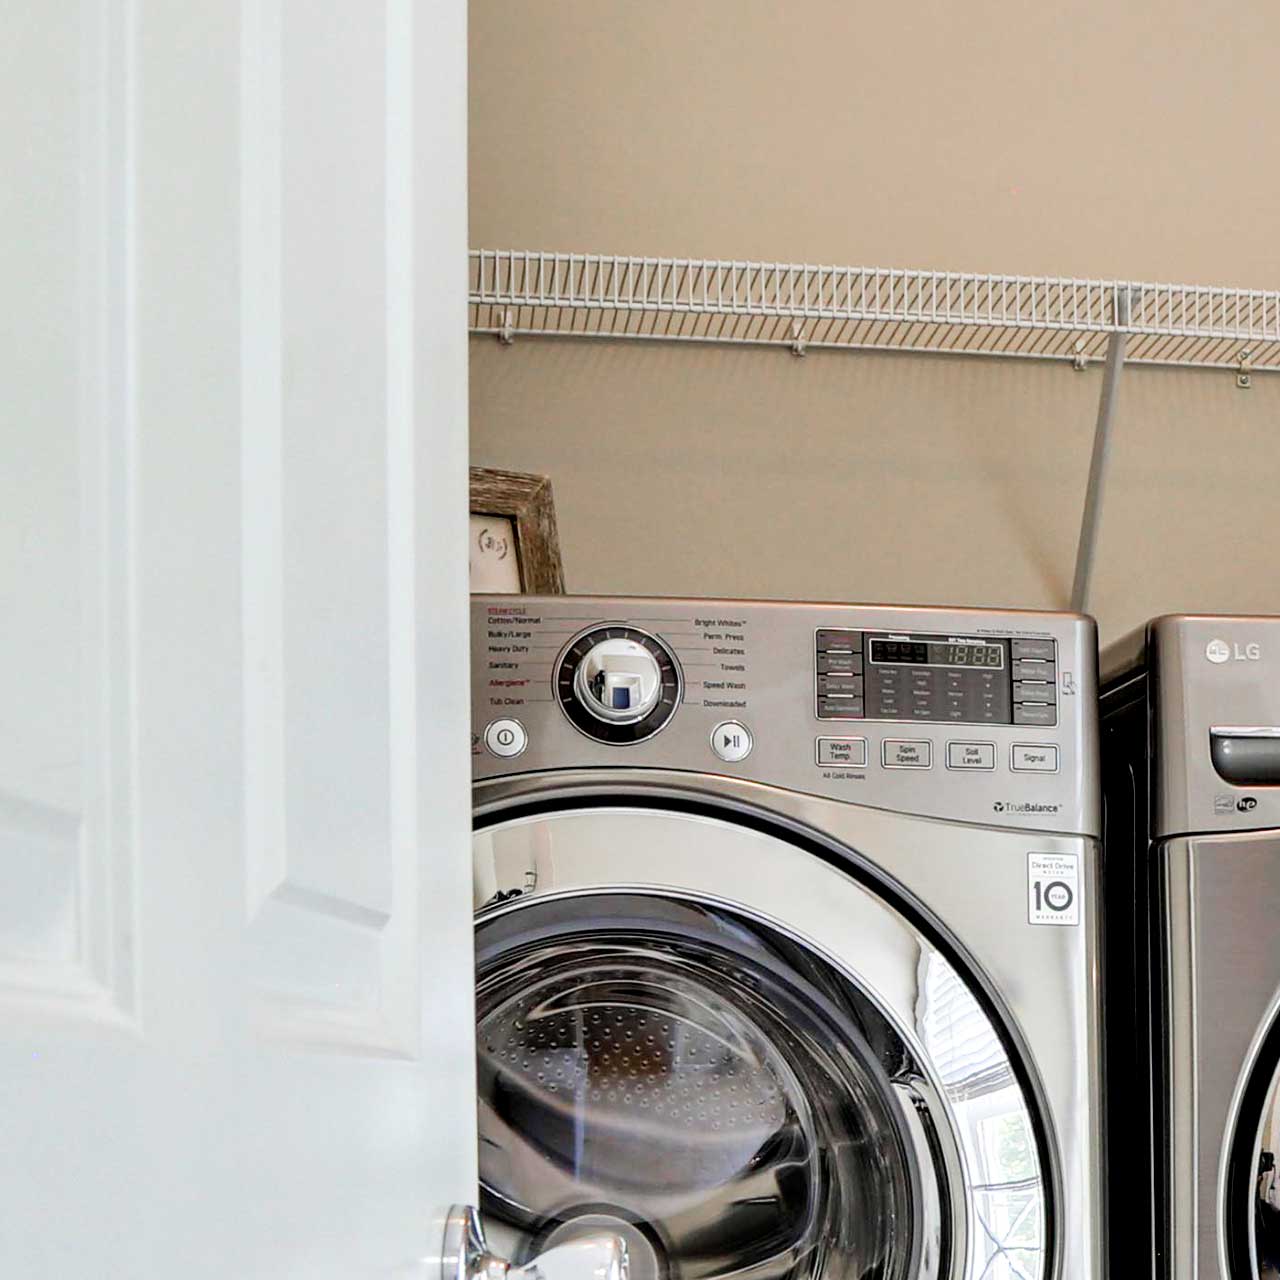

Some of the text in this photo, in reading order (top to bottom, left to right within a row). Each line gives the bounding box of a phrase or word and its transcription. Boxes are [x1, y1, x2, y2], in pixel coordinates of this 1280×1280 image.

[487, 616, 541, 624] Cotton/Normal
[694, 618, 716, 627] Bright
[488, 630, 531, 639] Bulky/Large
[725, 633, 744, 641] Press
[488, 645, 529, 653] Heavy Duty
[713, 647, 745, 655] Delicates
[1233, 642, 1261, 660] LG
[488, 661, 518, 669] Sanitary
[721, 663, 745, 671] Towels
[703, 680, 725, 689] Speed
[490, 697, 524, 705] Tub Clean
[703, 700, 747, 708] Downloaded
[830, 743, 852, 751] Wash
[899, 745, 916, 753] Spin
[965, 748, 979, 756] Soil
[896, 754, 920, 762] Speed
[1023, 753, 1046, 763] Signal
[1033, 881, 1073, 912] 10
